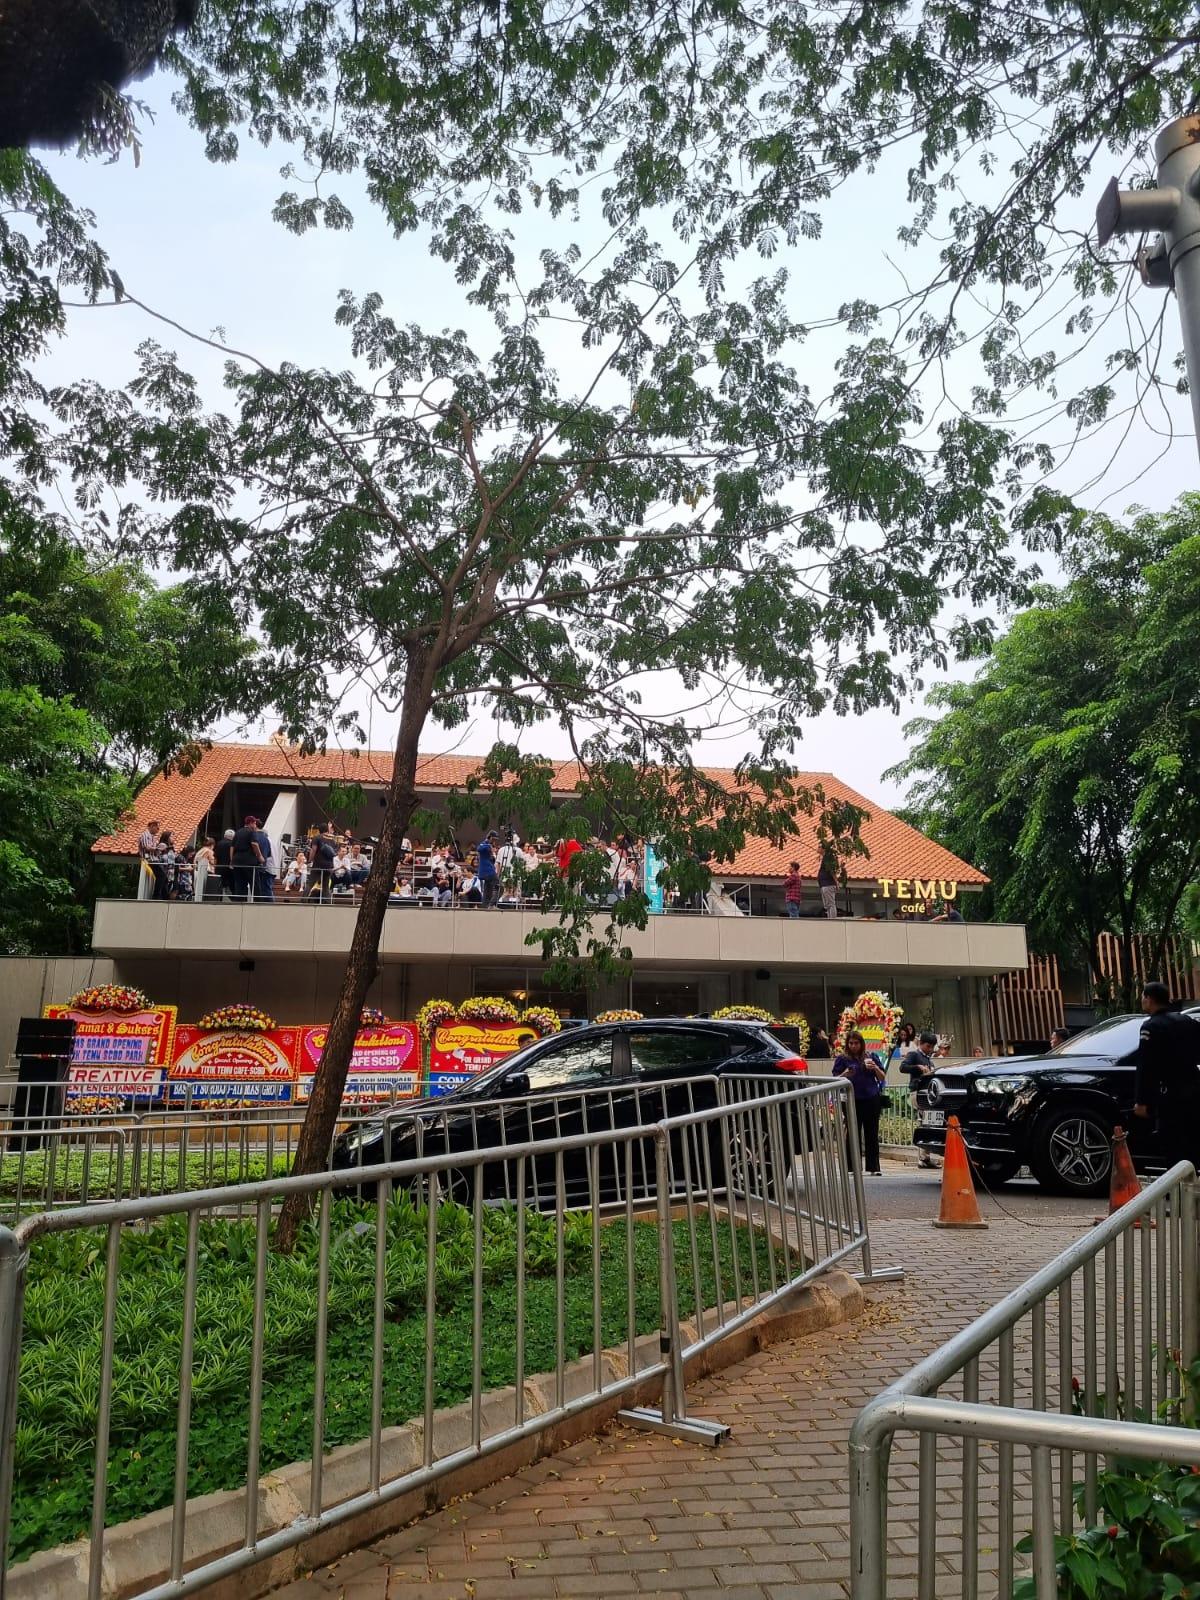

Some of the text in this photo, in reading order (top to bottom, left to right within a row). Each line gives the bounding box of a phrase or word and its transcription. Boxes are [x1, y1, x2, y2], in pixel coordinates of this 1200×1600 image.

[901, 903, 926, 913] café
[77, 1023, 159, 1035] amat & Sukses
[87, 1038, 110, 1049] GRAND
[113, 1039, 143, 1049] OPENING
[191, 1034, 277, 1062] Congratulations
[83, 1050, 101, 1060] TEMU
[103, 1050, 123, 1061] SCBD
[126, 1050, 143, 1061] PARK
[473, 1056, 491, 1064] GRAND
[371, 1056, 400, 1066] SCBD
[465, 1064, 481, 1072] TEMU
[87, 1084, 154, 1093] ENERAINMENT
[261, 1084, 284, 1096] GROP
